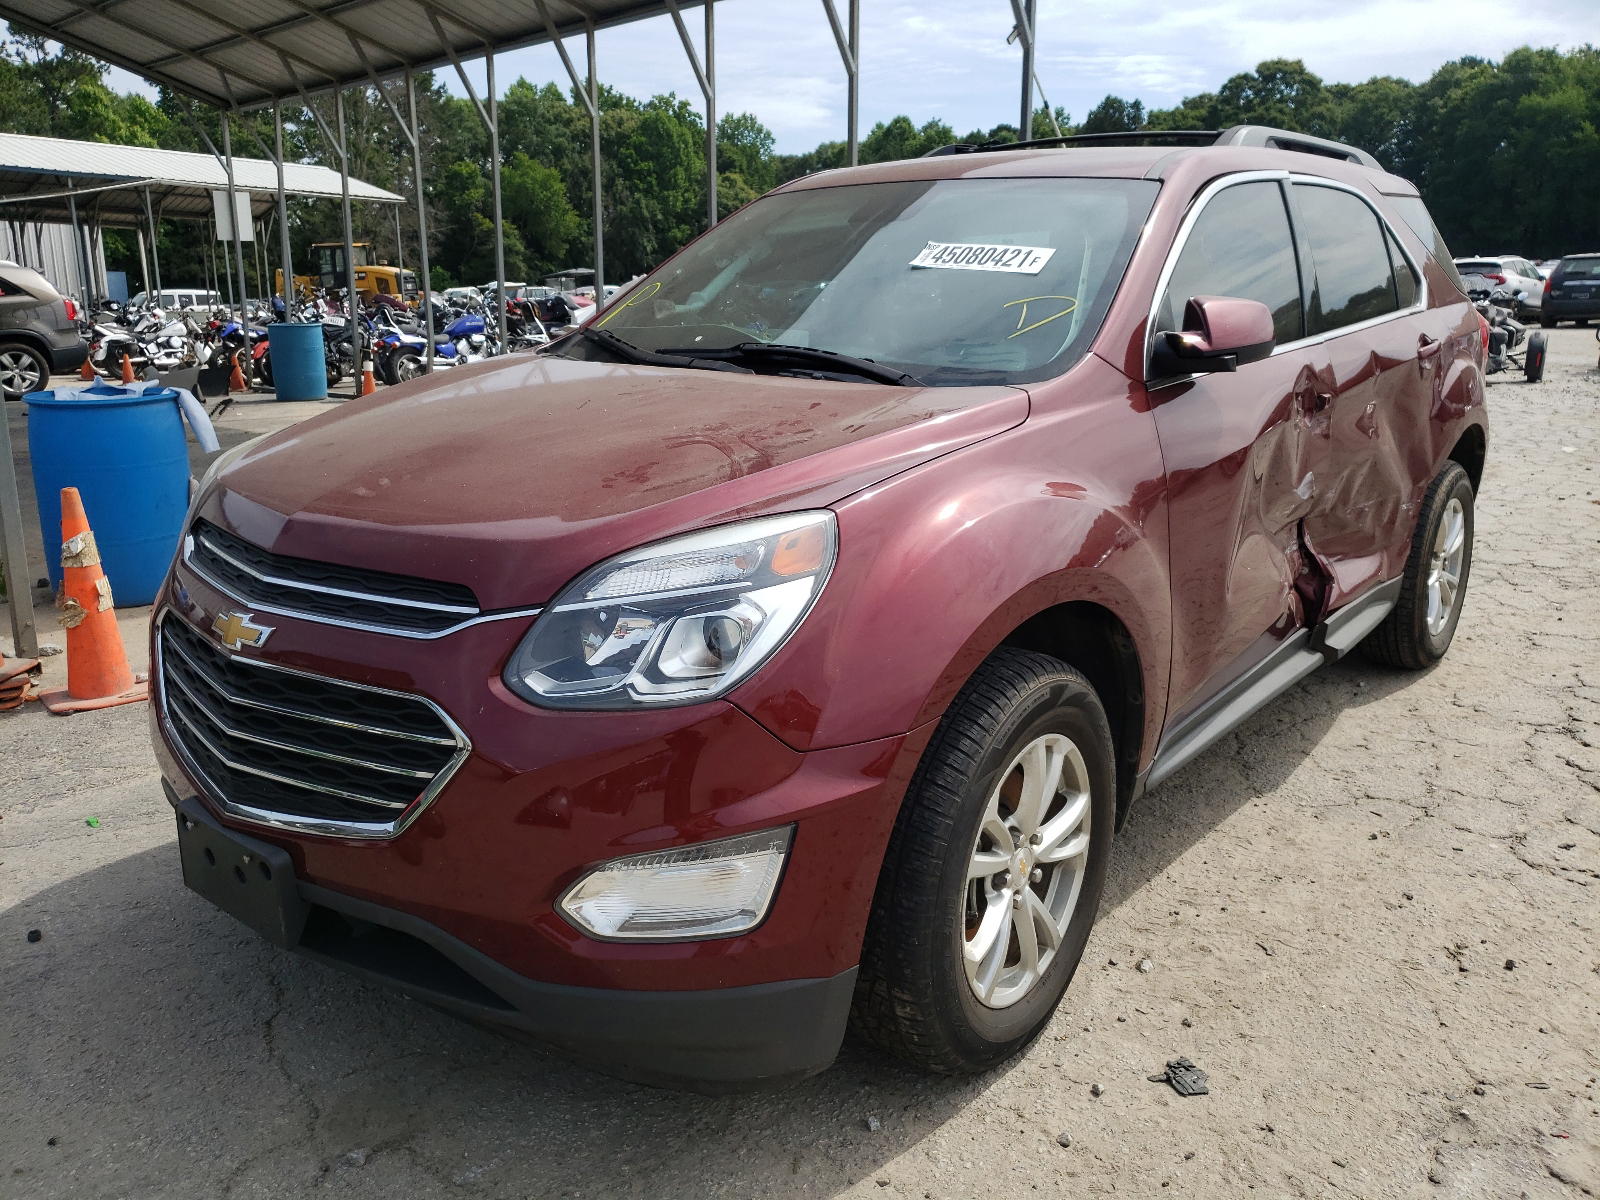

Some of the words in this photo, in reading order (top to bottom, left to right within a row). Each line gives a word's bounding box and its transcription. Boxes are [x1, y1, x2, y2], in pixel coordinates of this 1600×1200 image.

[932, 245, 1034, 268] 45080421
[1029, 256, 1042, 267] F
[597, 282, 663, 328] P
[1003, 295, 1079, 339] D
